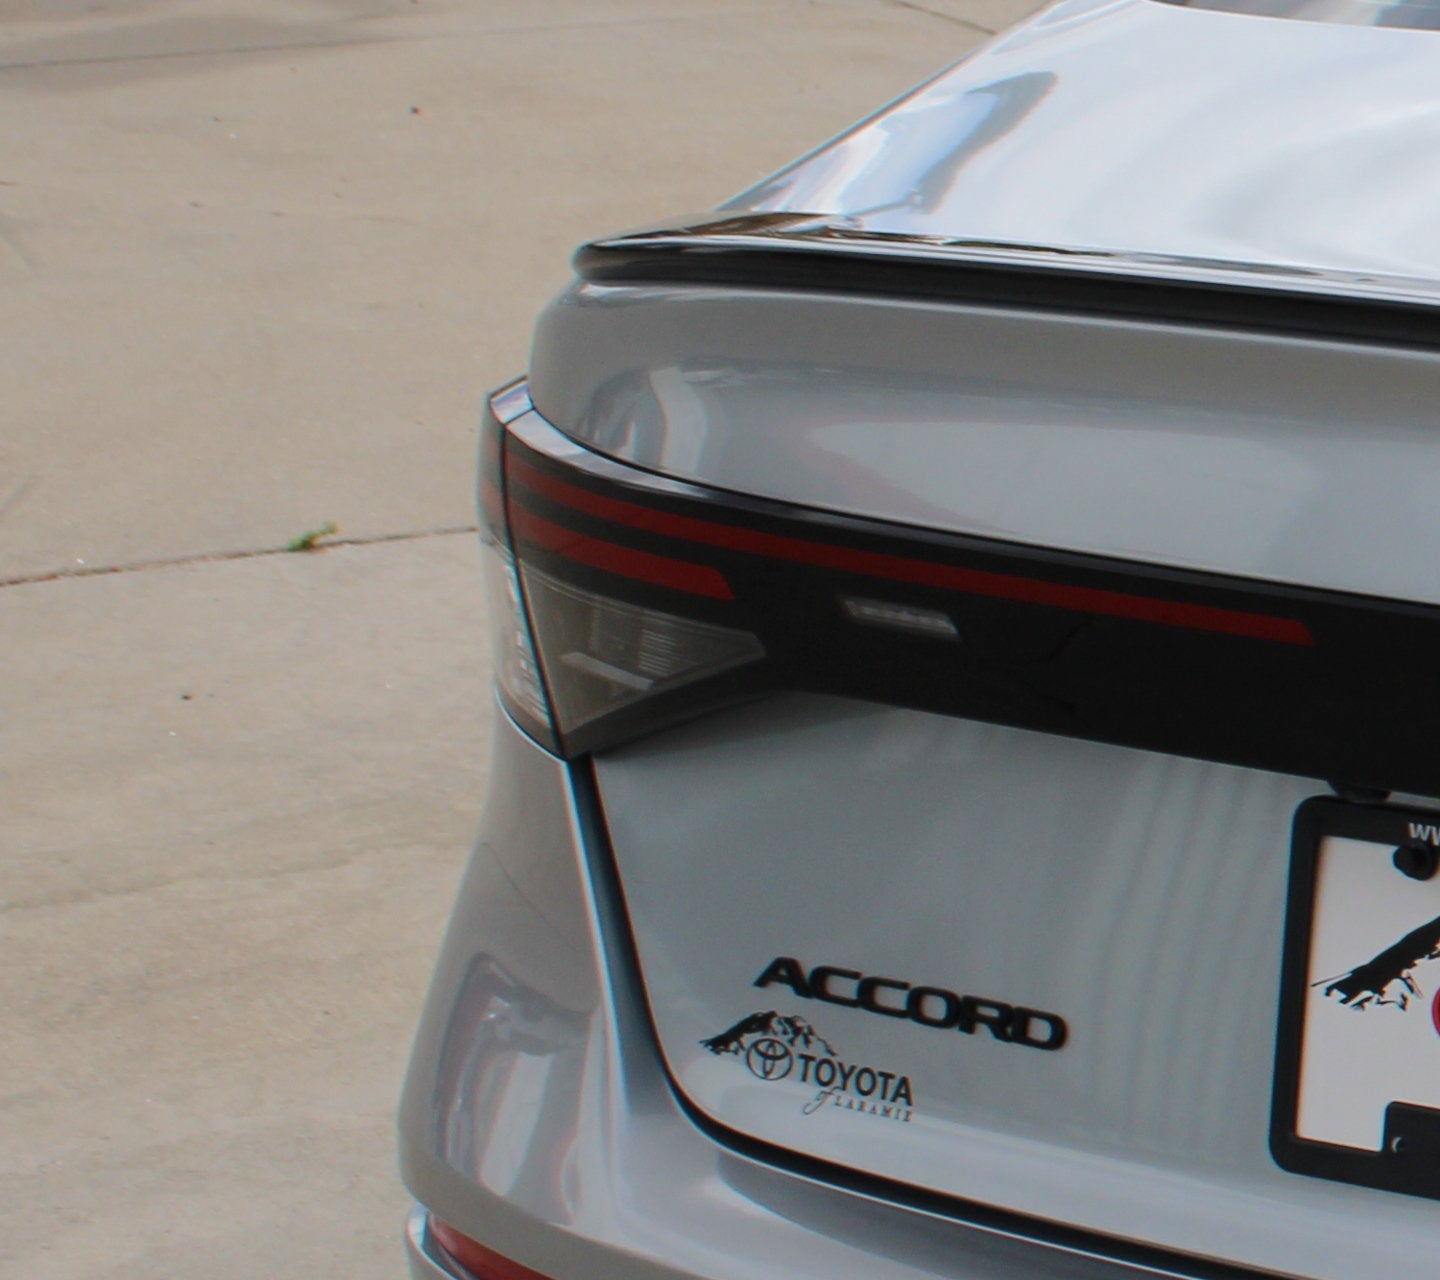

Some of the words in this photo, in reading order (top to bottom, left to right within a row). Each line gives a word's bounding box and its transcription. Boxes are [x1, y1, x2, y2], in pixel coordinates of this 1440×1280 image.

[753, 956, 1070, 1051] ACCORD
[799, 1053, 914, 1107] TOYOTA
[834, 1095, 914, 1122] LARAMIE
